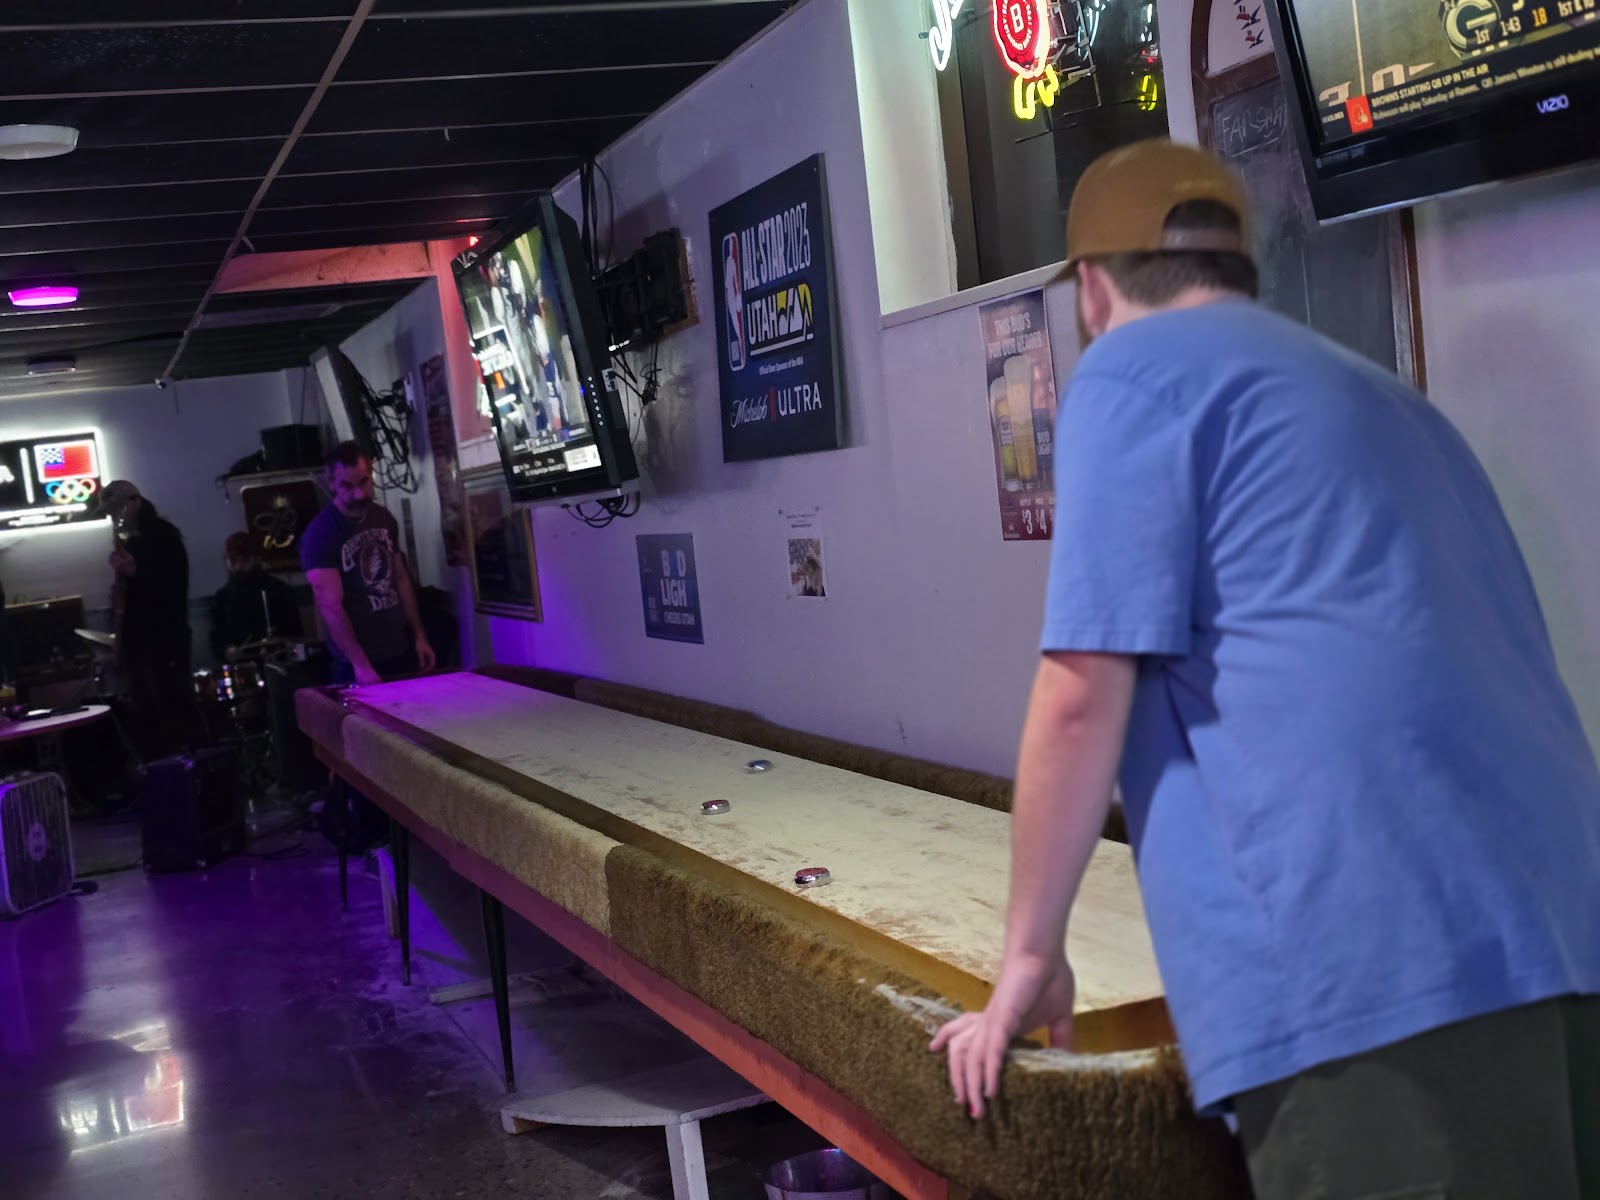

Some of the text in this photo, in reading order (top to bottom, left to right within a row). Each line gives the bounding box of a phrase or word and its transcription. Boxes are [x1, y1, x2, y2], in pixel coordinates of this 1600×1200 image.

[1010, 3, 1025, 33] B
[1475, 7, 1548, 44] 1ST 1:43 18
[1558, 1, 1573, 17] 1ST
[1371, 63, 1489, 107] BROWNS STARTING QB UP IN THE AIR
[1536, 94, 1569, 113] VIZIO
[784, 202, 811, 274] 2023
[747, 293, 778, 345] UTAH
[730, 382, 822, 428] Michelob ULTRA
[1022, 509, 1034, 535] $3
[661, 550, 687, 577] BD
